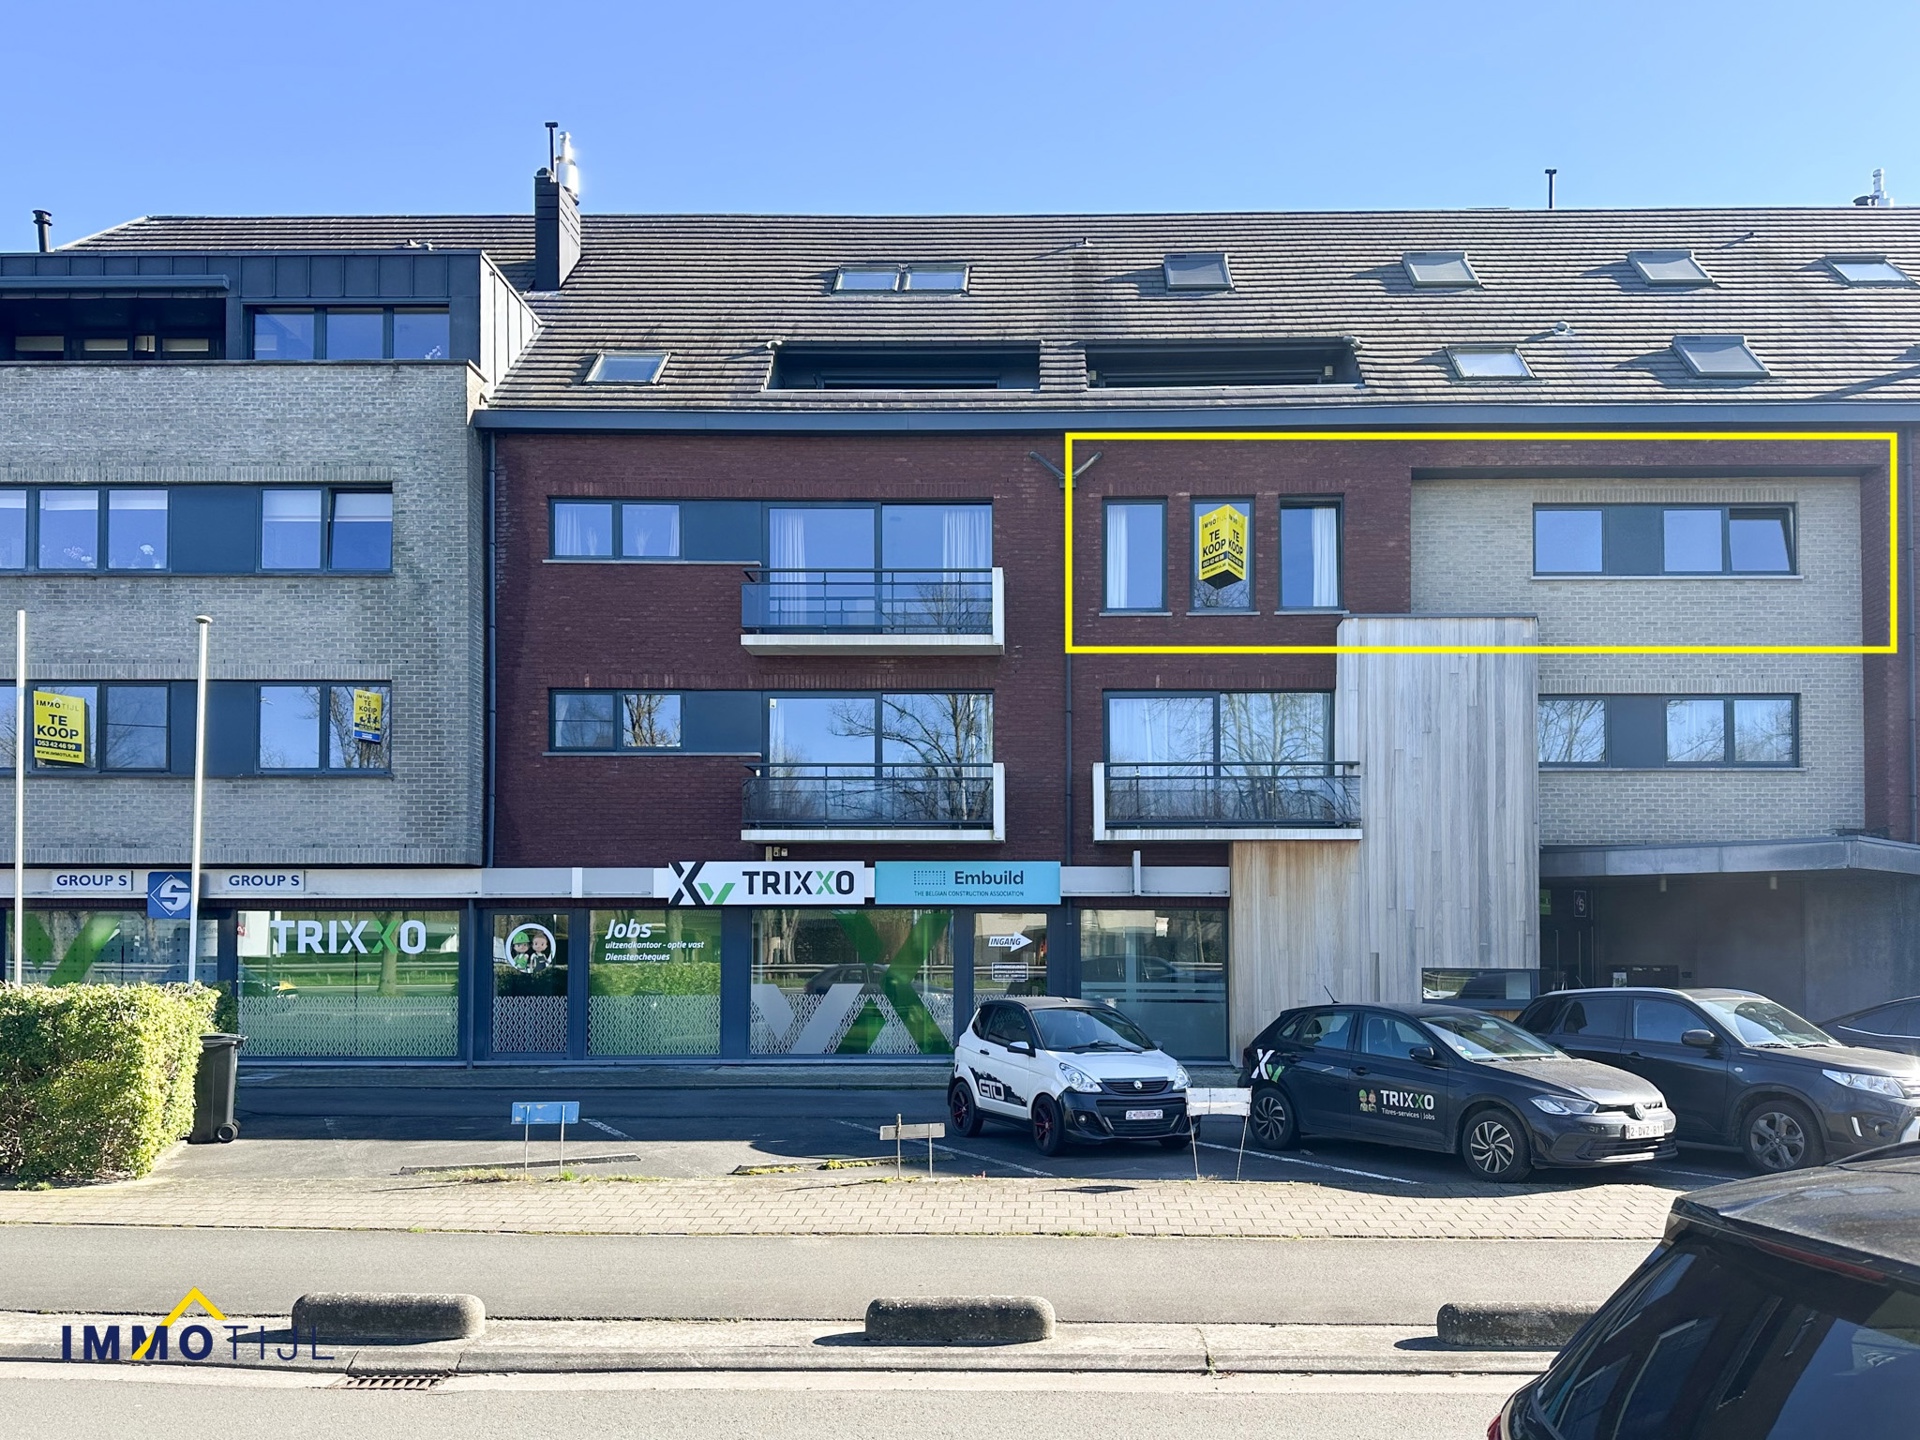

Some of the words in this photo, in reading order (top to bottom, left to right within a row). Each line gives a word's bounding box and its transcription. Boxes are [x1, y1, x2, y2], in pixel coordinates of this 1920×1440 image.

[1209, 529, 1220, 542] TE
[1233, 529, 1240, 543] TE
[1203, 539, 1226, 557] KOOP
[1228, 538, 1243, 556] KOOP
[48, 713, 68, 727] TE
[37, 724, 79, 740] KOOP
[56, 874, 113, 887] GROUP
[118, 874, 127, 887] S
[228, 874, 286, 887] GROUP
[290, 874, 300, 887] S
[742, 870, 855, 895] TRIXXO
[954, 870, 1024, 885] Embuild
[605, 919, 652, 940] Jobs
[270, 919, 427, 955] TRIXXO
[990, 937, 1021, 946] INGANG
[605, 941, 662, 949] uitzendkantoor
[667, 941, 687, 950] optie
[688, 941, 704, 949] vast
[605, 952, 670, 962] Dienstencheques
[1380, 1090, 1435, 1110] TRIXXO
[1381, 1107, 1420, 1119] Titres-services
